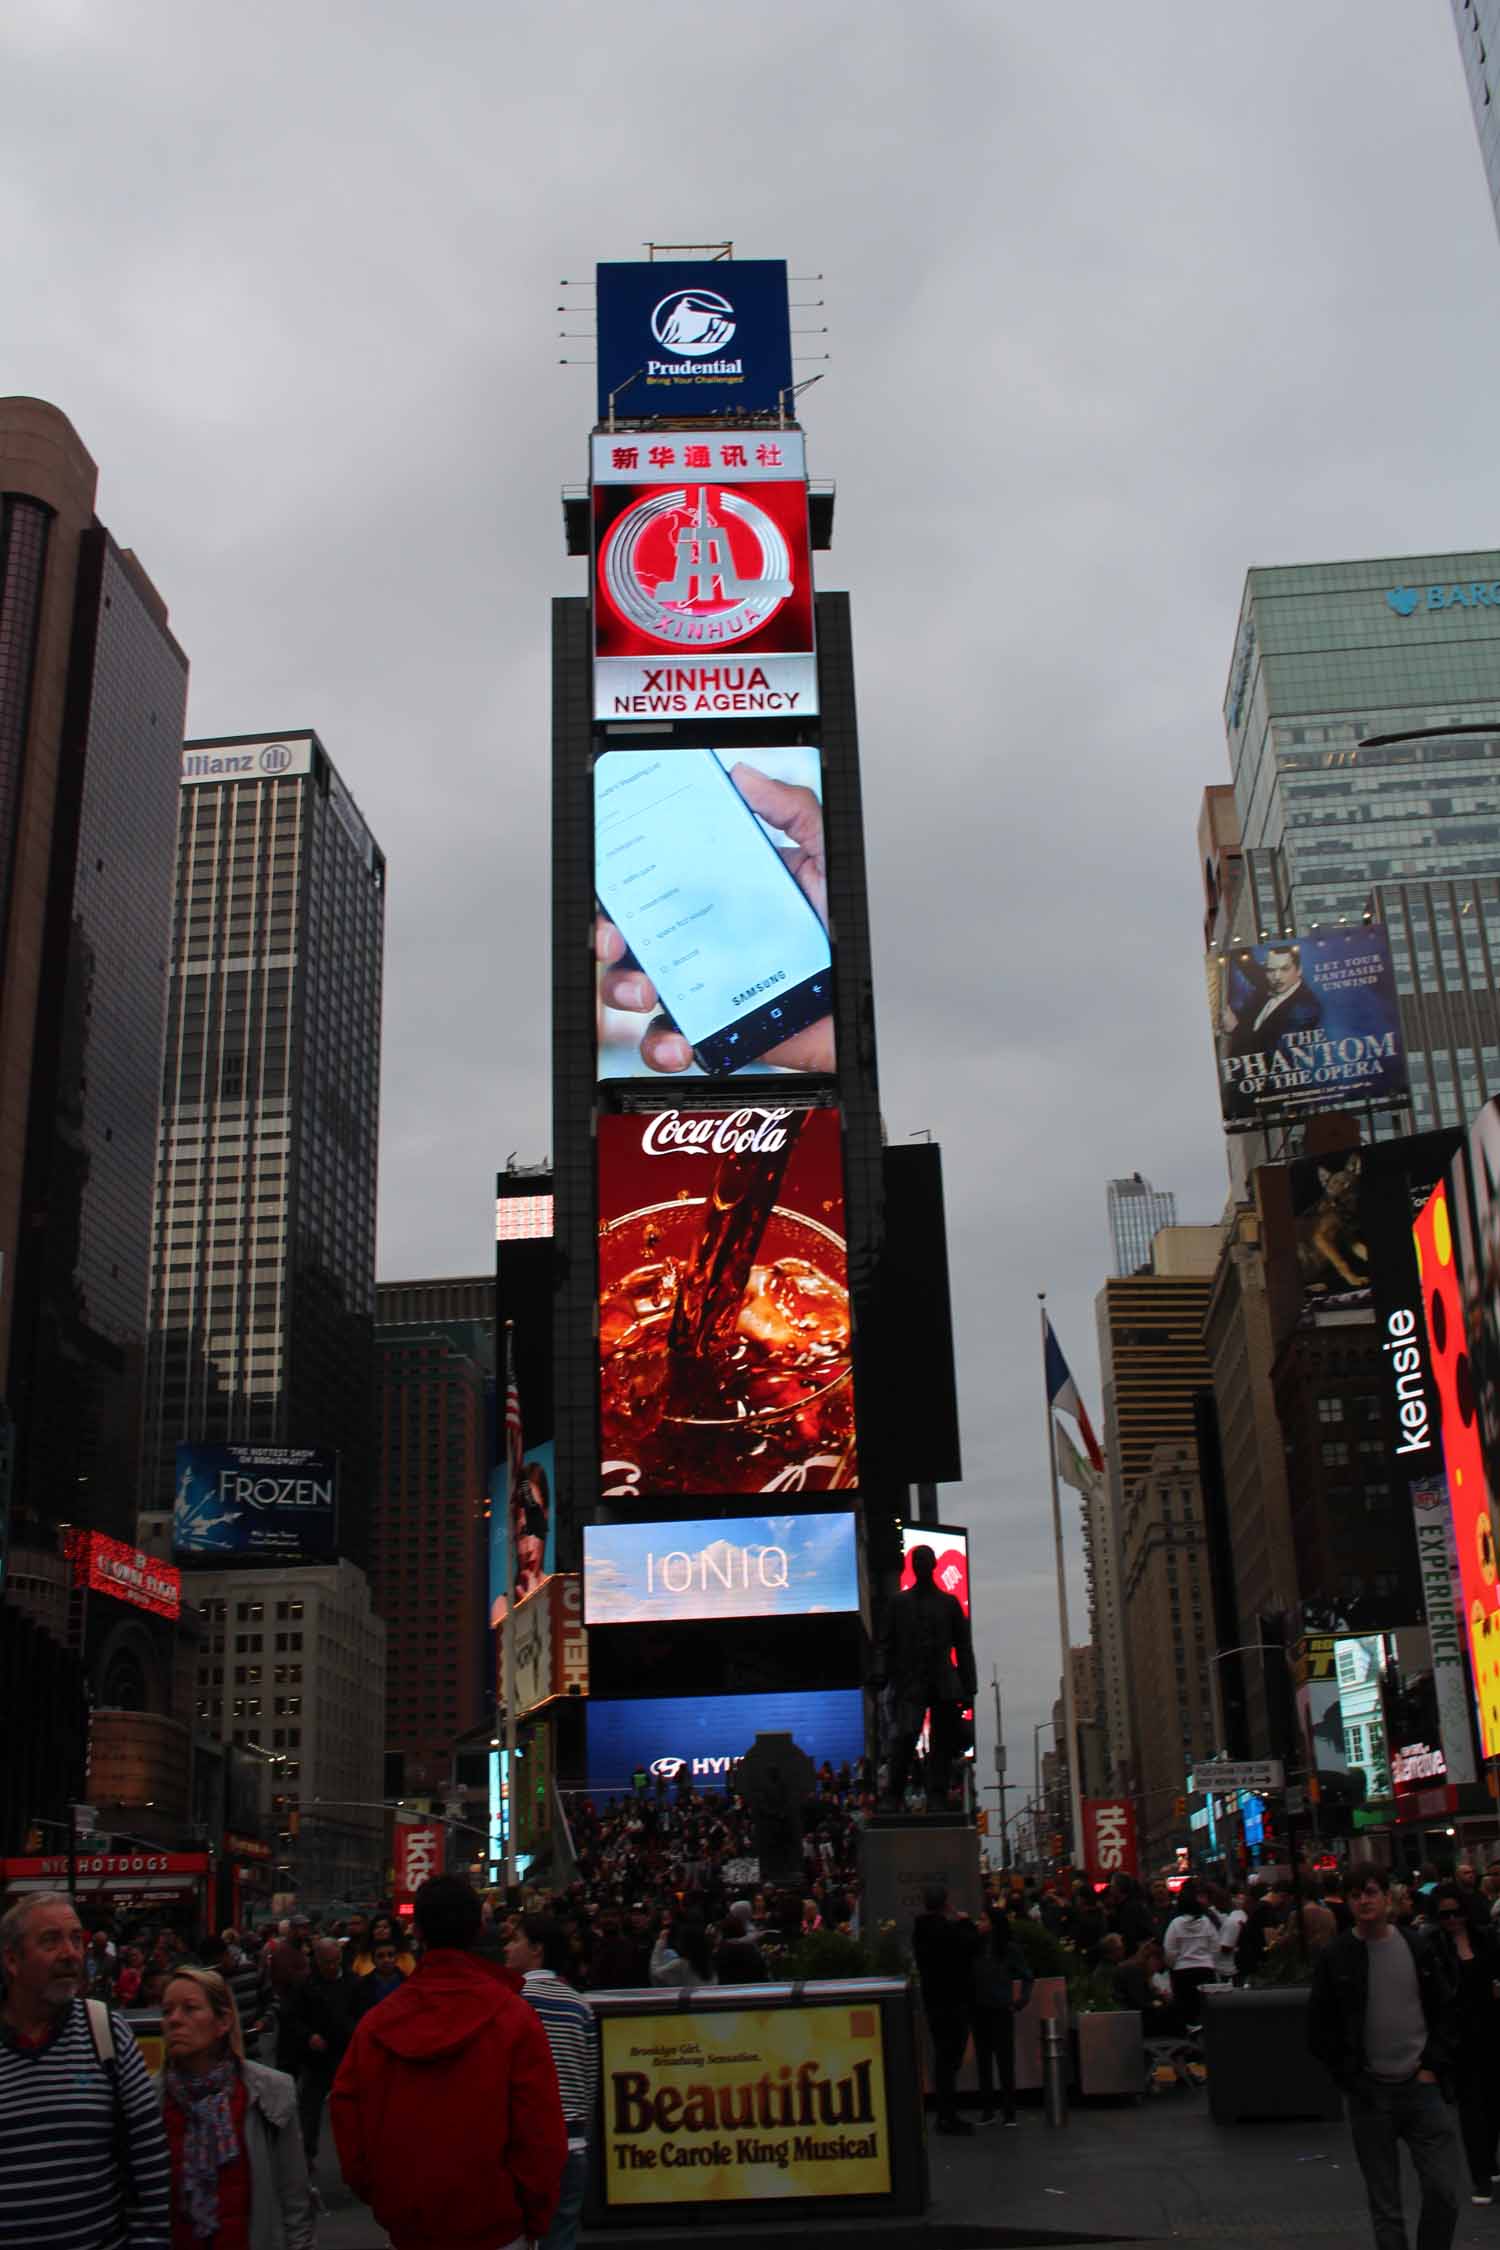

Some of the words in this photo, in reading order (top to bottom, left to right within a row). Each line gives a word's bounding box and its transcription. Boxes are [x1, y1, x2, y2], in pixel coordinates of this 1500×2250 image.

[647, 359, 743, 375] Prudential
[611, 444, 783, 470] 新华通讯社
[653, 607, 761, 640] XINHUA
[642, 666, 770, 692] XINHUA
[614, 694, 687, 714] NEWS
[694, 692, 800, 712] AGENCY
[1314, 962, 1340, 973] LET
[1345, 953, 1381, 968] YOUR
[731, 970, 787, 1007] SAMSUNG
[1281, 1028, 1328, 1048] THE
[1221, 1031, 1398, 1083] PHANTOM
[1239, 1076, 1267, 1094] OF
[1270, 1068, 1313, 1089] THE
[1314, 1059, 1384, 1082] OPERA
[641, 1107, 795, 1156] Coca-Cola
[1384, 1308, 1432, 1454] kensie
[218, 1470, 333, 1510] FROZEN
[646, 1546, 791, 1593] IONIQ
[1419, 1525, 1463, 1667] EXPERIENCE
[1094, 1805, 1128, 1871] tkts
[78, 1856, 169, 1873] HOTDOGS
[407, 1831, 434, 1892] tkts
[611, 2058, 876, 2136] Beautiful
[613, 2142, 657, 2170] The
[659, 2140, 733, 2168] Carole
[735, 2137, 790, 2169] King
[793, 2132, 878, 2162] Musical
